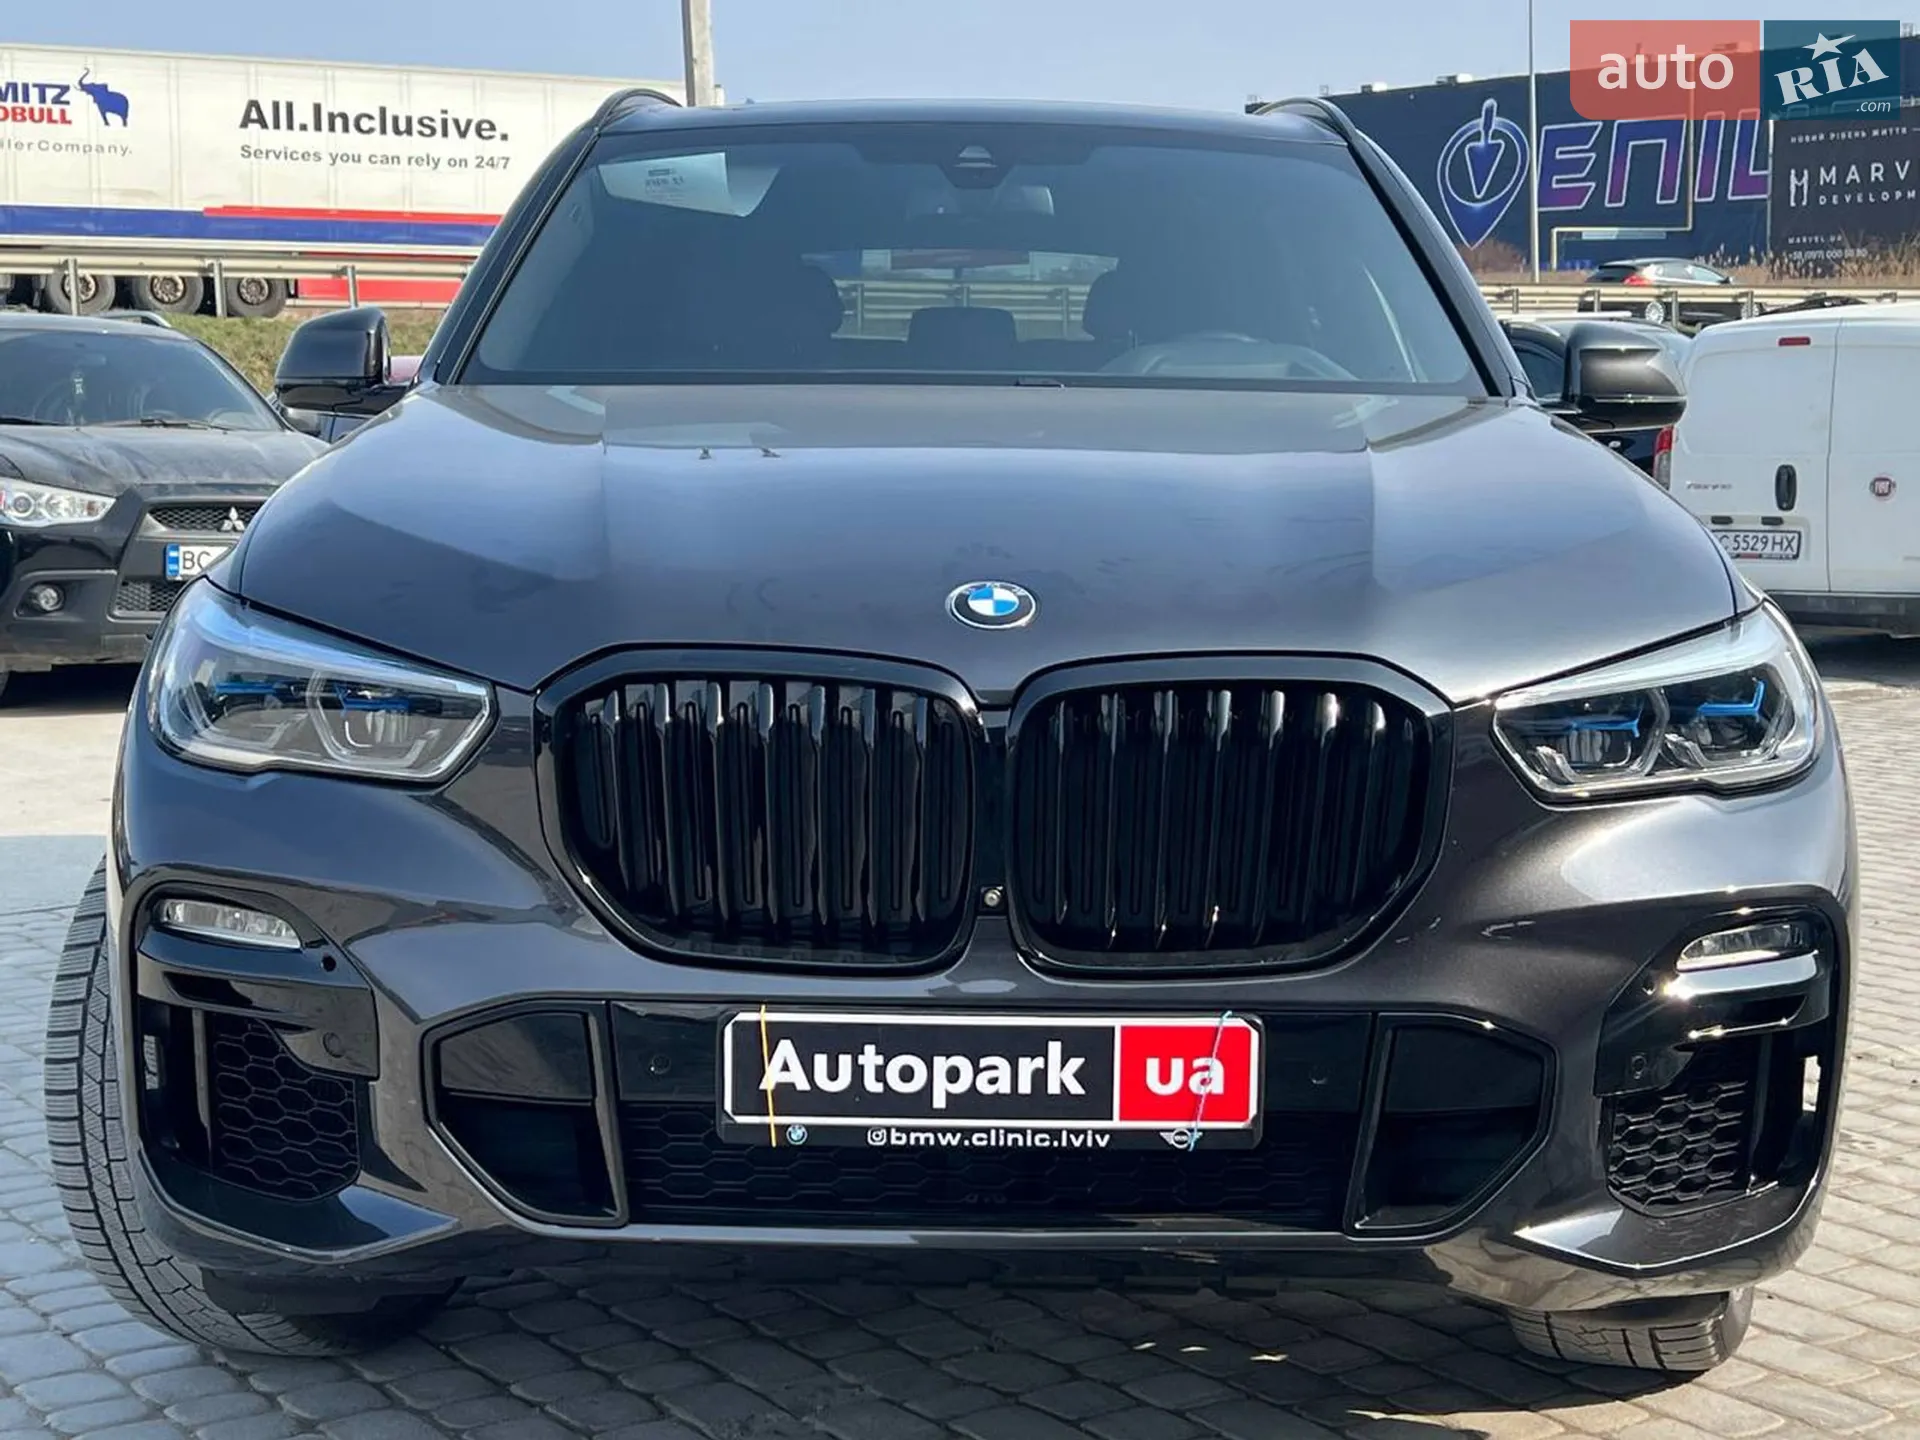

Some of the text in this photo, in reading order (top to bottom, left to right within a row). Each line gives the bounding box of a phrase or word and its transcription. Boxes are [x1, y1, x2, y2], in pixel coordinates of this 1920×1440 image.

[239, 99, 509, 142] All.Inclusive.
[240, 144, 511, 171] Services you can rely on 24/7
[1819, 160, 1911, 186] MARV
[1732, 535, 1769, 552] 5529
[1772, 535, 1797, 552] HX
[758, 1038, 1225, 1109] Autopark ua
